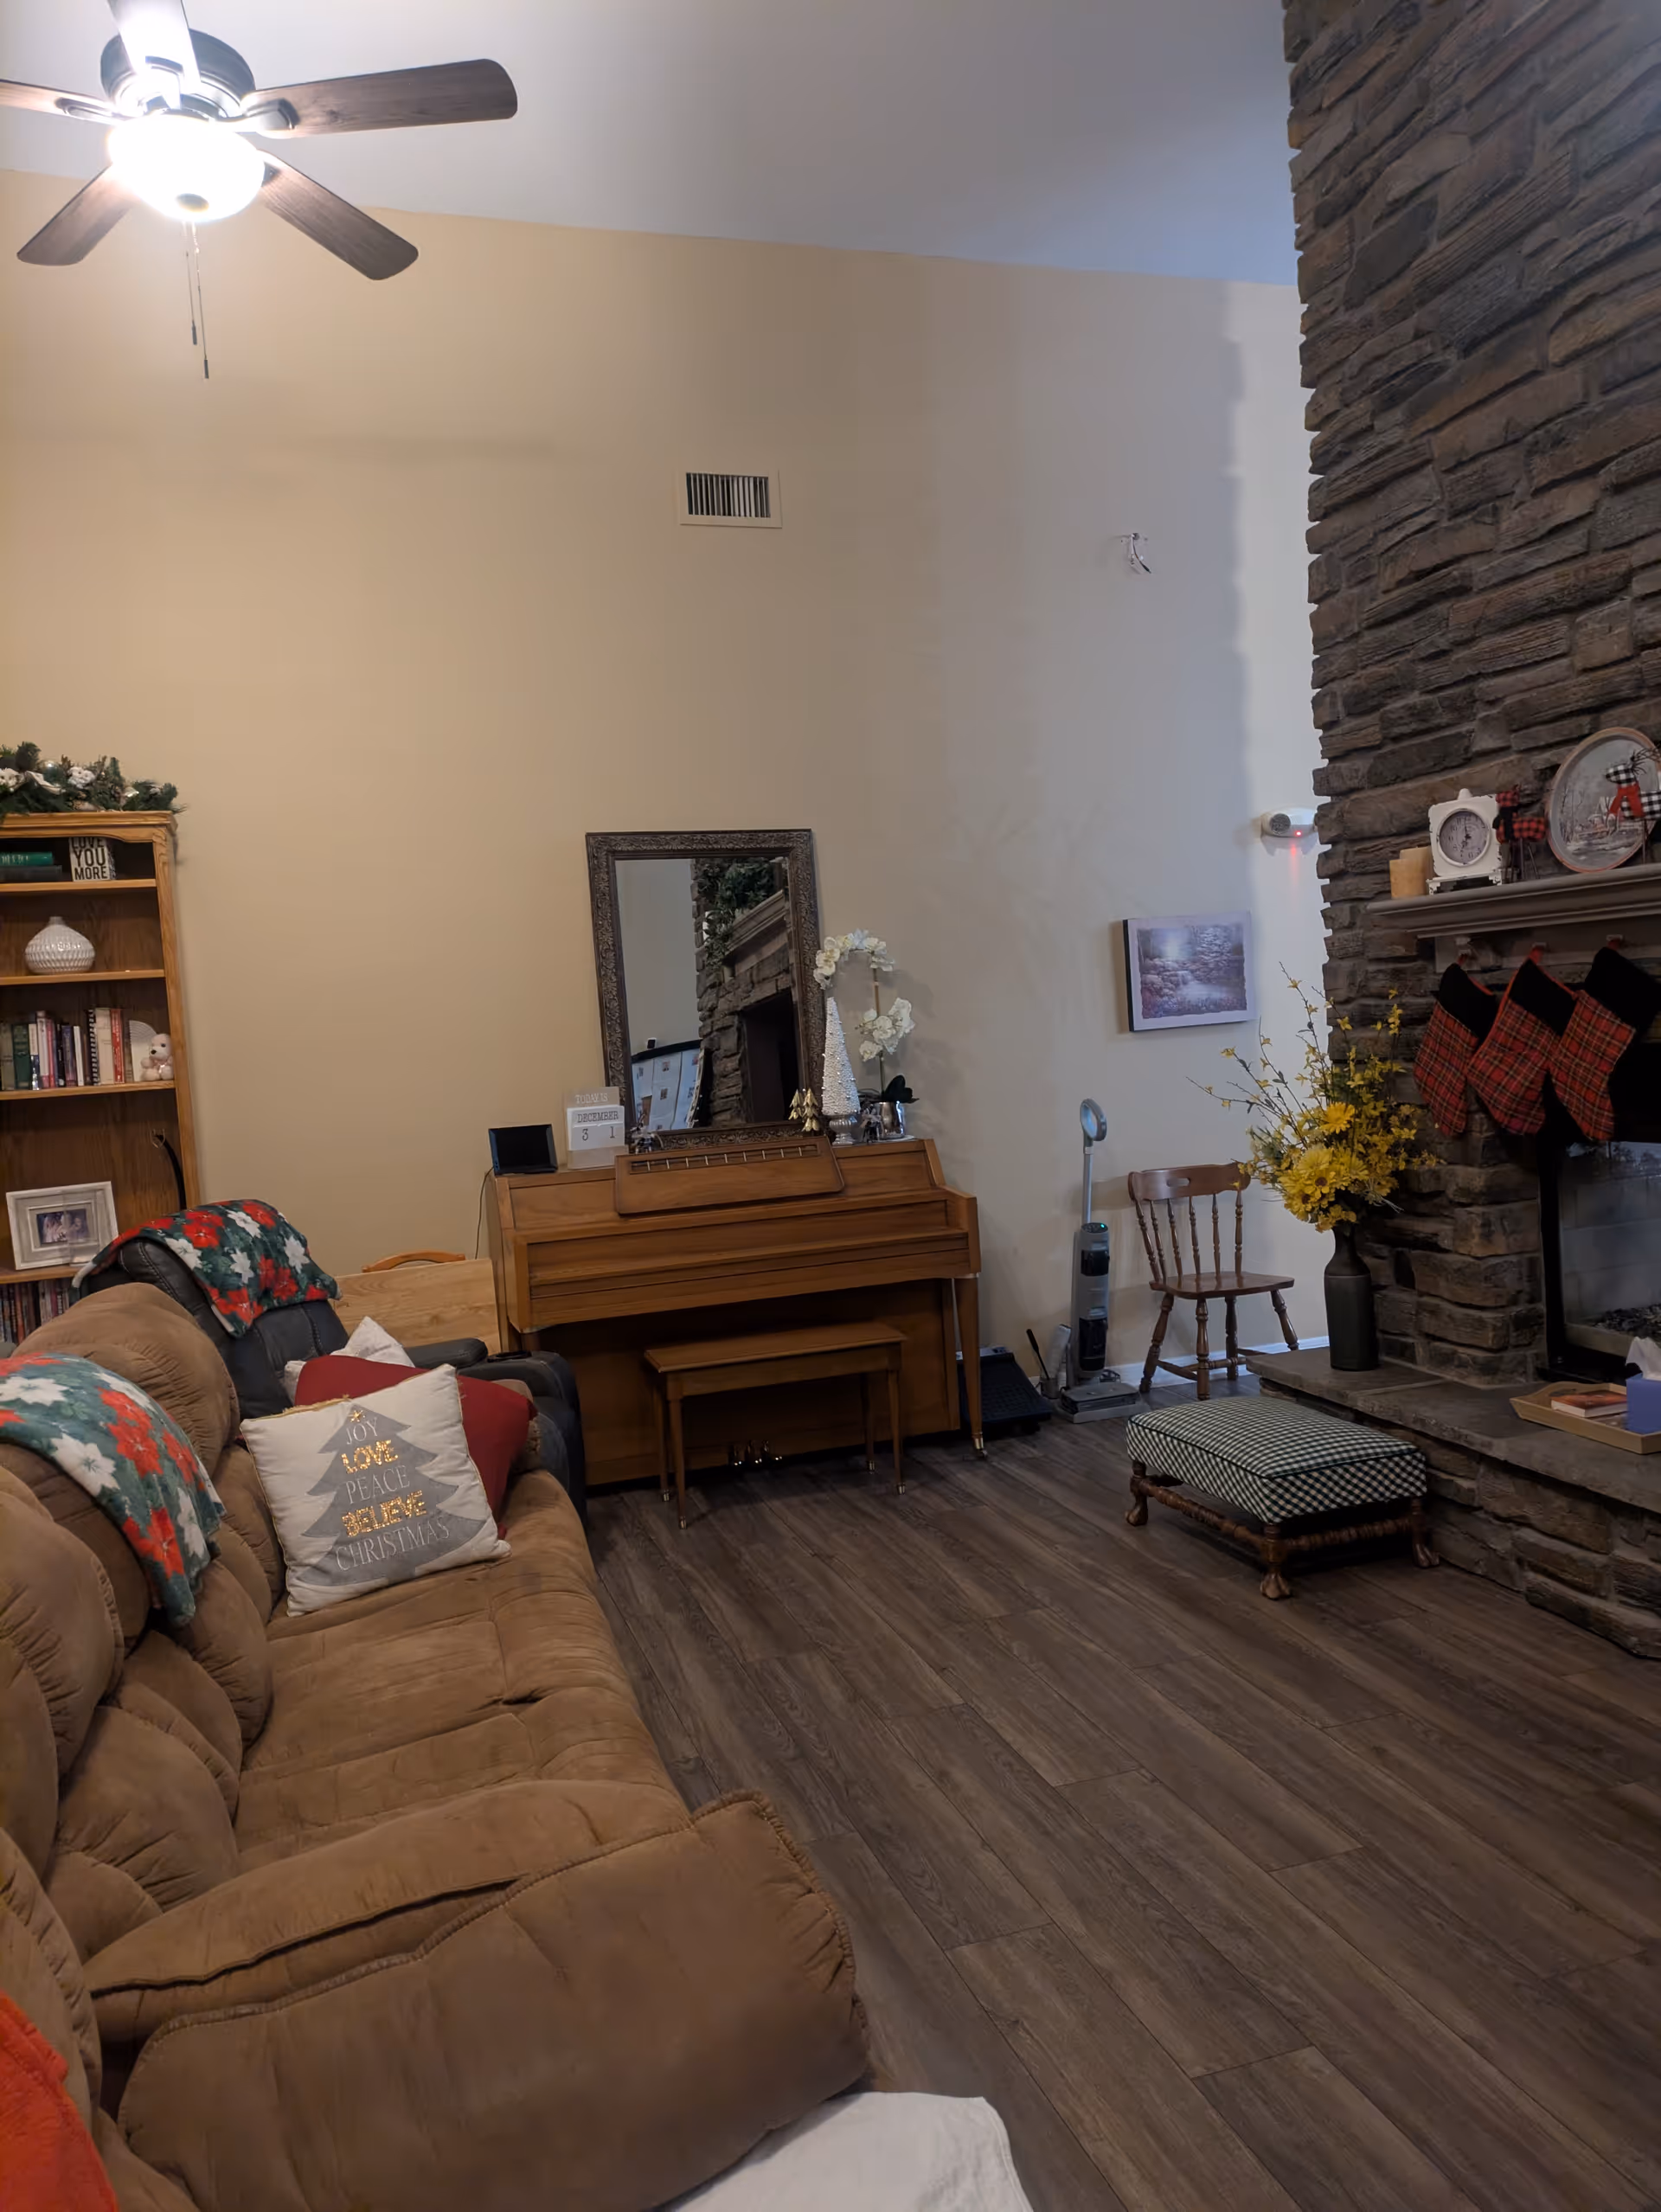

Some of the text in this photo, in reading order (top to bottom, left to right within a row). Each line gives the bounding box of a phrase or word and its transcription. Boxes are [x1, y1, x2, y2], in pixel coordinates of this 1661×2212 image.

[71, 837, 105, 849] LOVE
[73, 849, 106, 867] YOU
[74, 866, 108, 881] MORE
[575, 1093, 608, 1104] TODAY IS
[577, 1111, 619, 1123] DECEMBER
[582, 1126, 615, 1141] 3 1
[346, 1417, 378, 1445] JOY
[342, 1439, 399, 1474] LOVE
[346, 1465, 410, 1504] PEACE
[342, 1490, 427, 1538] BELIEVE
[336, 1515, 450, 1571] CHRISTMAS
